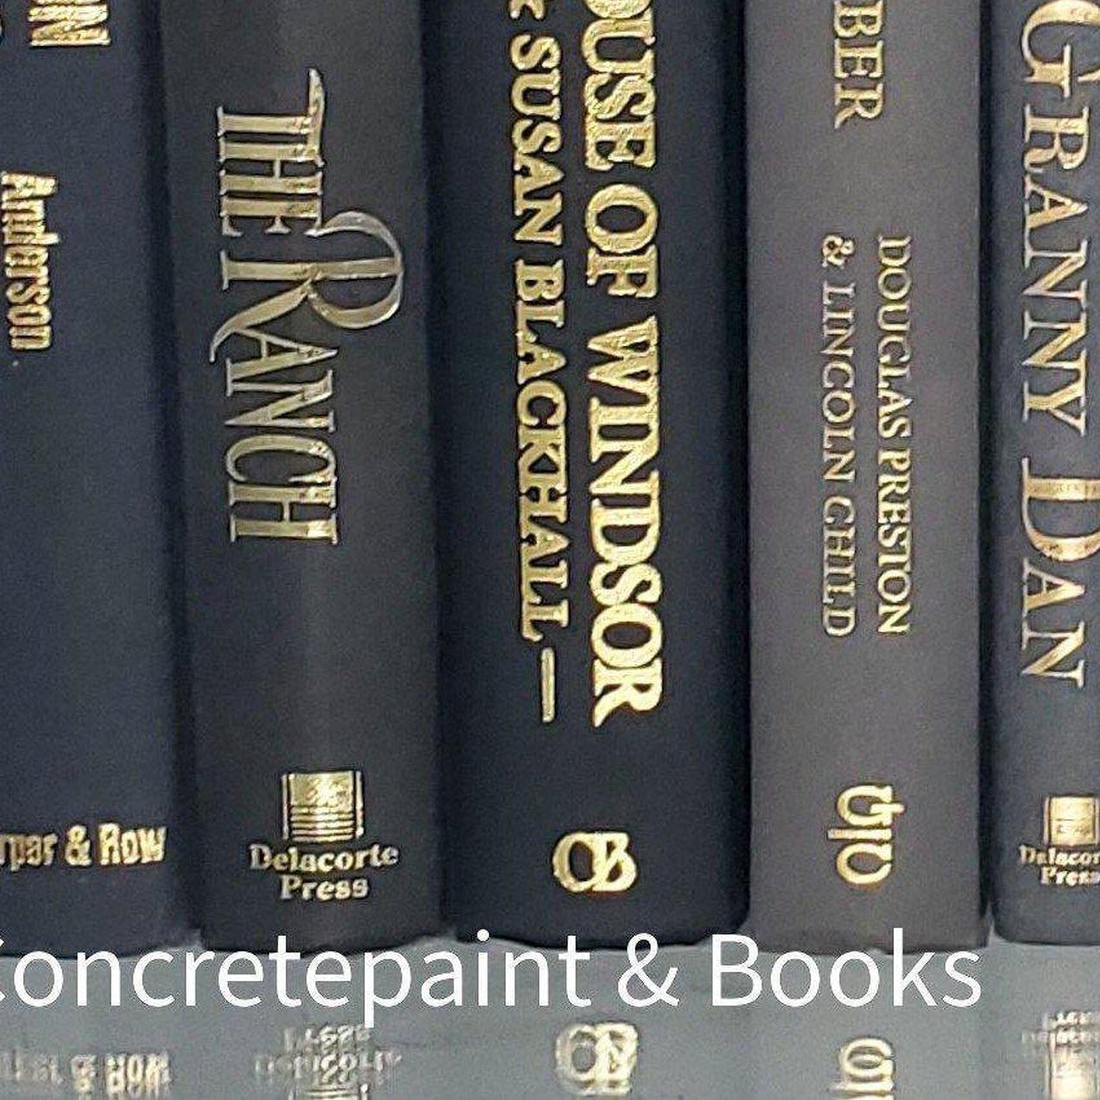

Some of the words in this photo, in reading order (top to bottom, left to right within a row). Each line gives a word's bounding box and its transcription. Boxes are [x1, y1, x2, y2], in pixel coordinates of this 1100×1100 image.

[217, 68, 325, 238] THE
[511, 35, 564, 245] SUSAN
[0, 171, 60, 349] Anderson
[585, 184, 657, 298] OF
[822, 236, 853, 267] &
[210, 211, 404, 545] RANCH
[822, 282, 855, 482] LINCOLN
[878, 236, 912, 437] DOUGLAS
[516, 259, 569, 641] BLACKHALL
[587, 315, 662, 727] WINDSOR
[823, 497, 855, 636] CHILD
[878, 449, 911, 632] PRESTON
[65, 825, 91, 866] &
[99, 823, 166, 865] Row
[249, 843, 399, 872] Delacorte
[283, 876, 367, 900] Press
